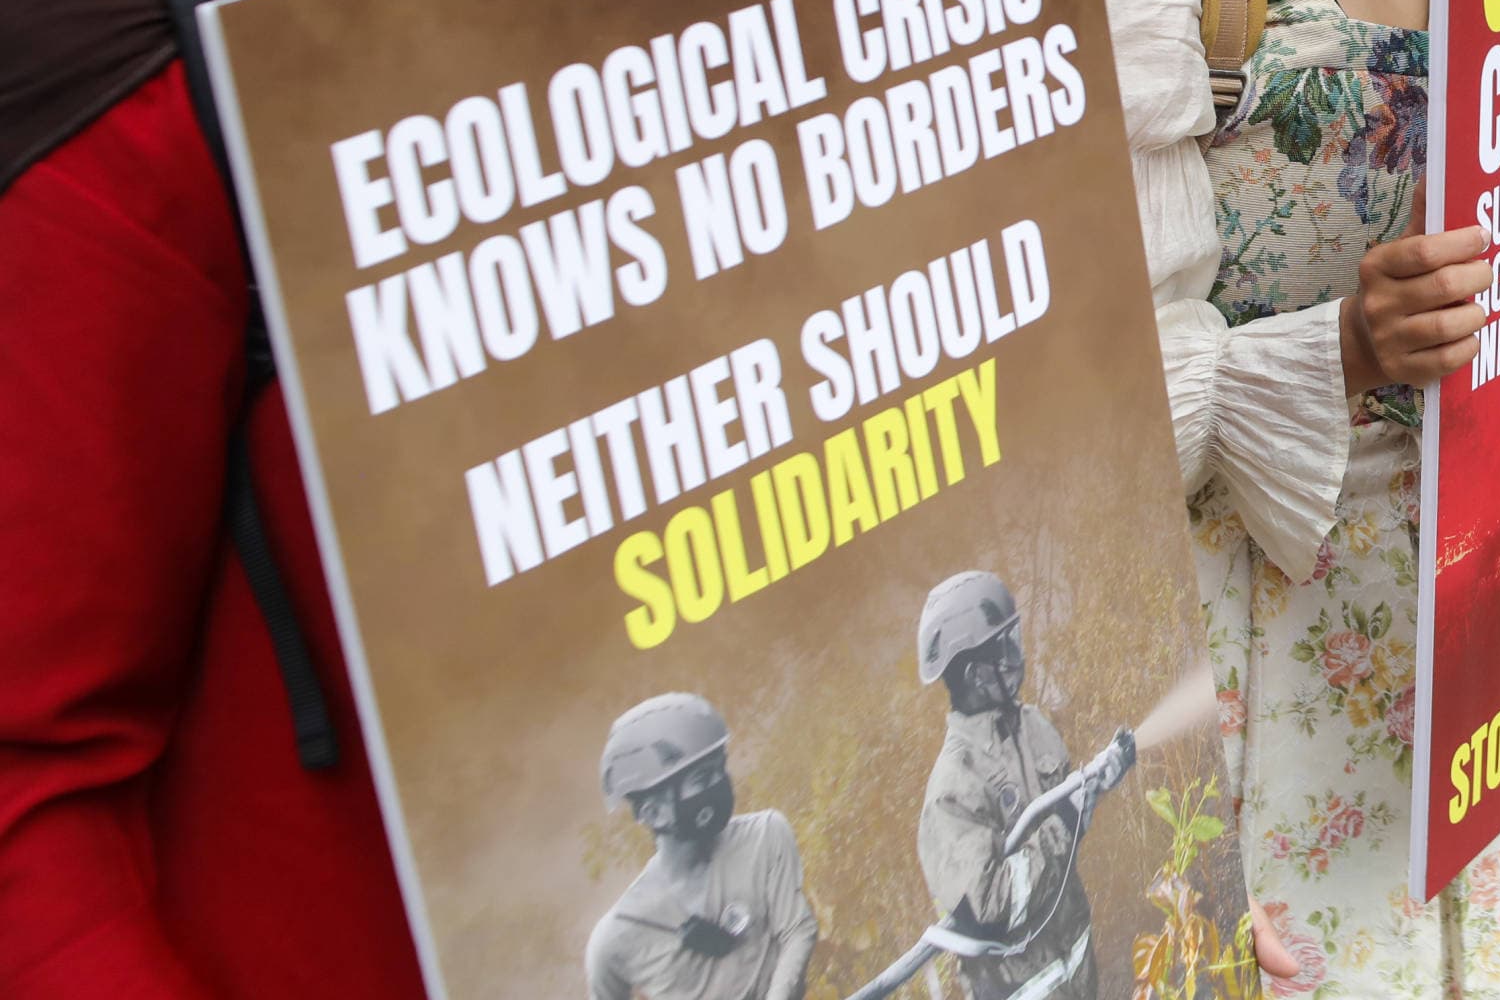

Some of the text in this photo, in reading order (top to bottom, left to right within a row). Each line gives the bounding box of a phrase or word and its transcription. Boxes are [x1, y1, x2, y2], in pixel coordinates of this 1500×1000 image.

[345, 23, 1088, 416] KNOWS NO BORDERS
[465, 219, 1052, 588] NEITHER SHOULD
[614, 358, 1003, 650] SOLIDARITY
